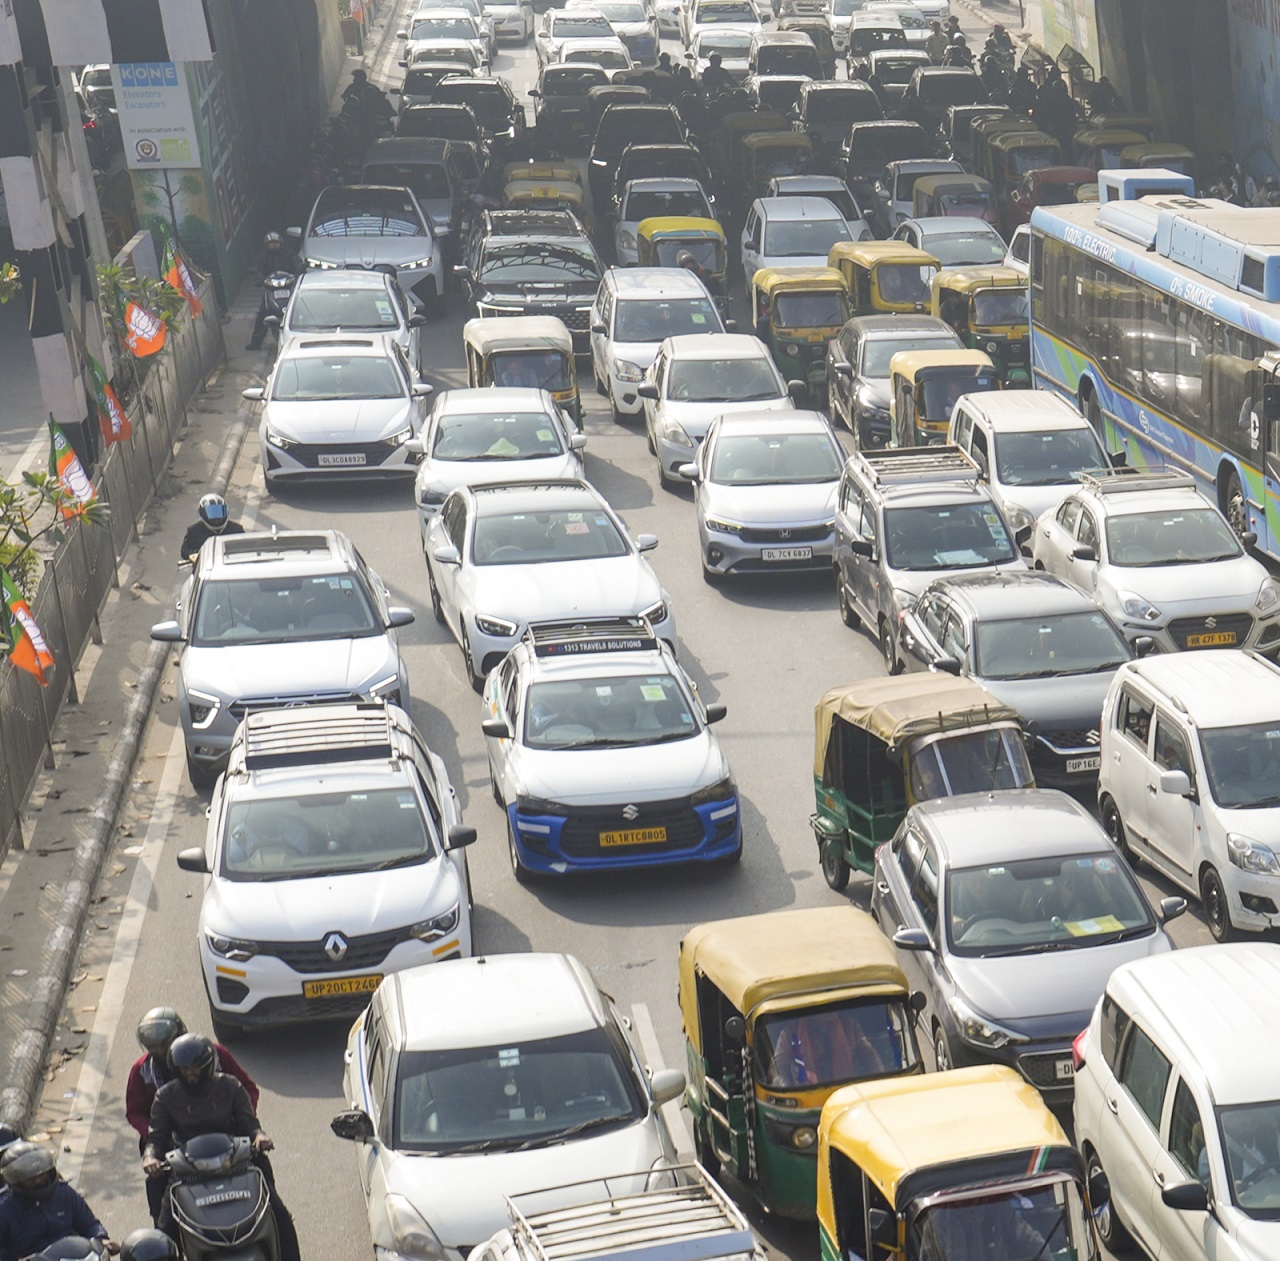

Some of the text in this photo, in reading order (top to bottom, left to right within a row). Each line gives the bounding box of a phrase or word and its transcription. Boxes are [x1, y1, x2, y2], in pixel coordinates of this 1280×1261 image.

[121, 67, 175, 79] KONE
[123, 90, 161, 98] Elevators
[124, 101, 166, 110] Escalators
[1063, 226, 1083, 247] 100%
[1170, 277, 1184, 296] 0%
[564, 640, 642, 653] 1313 TRAVELS SOLUTIONS
[1072, 759, 1098, 770] UP16E
